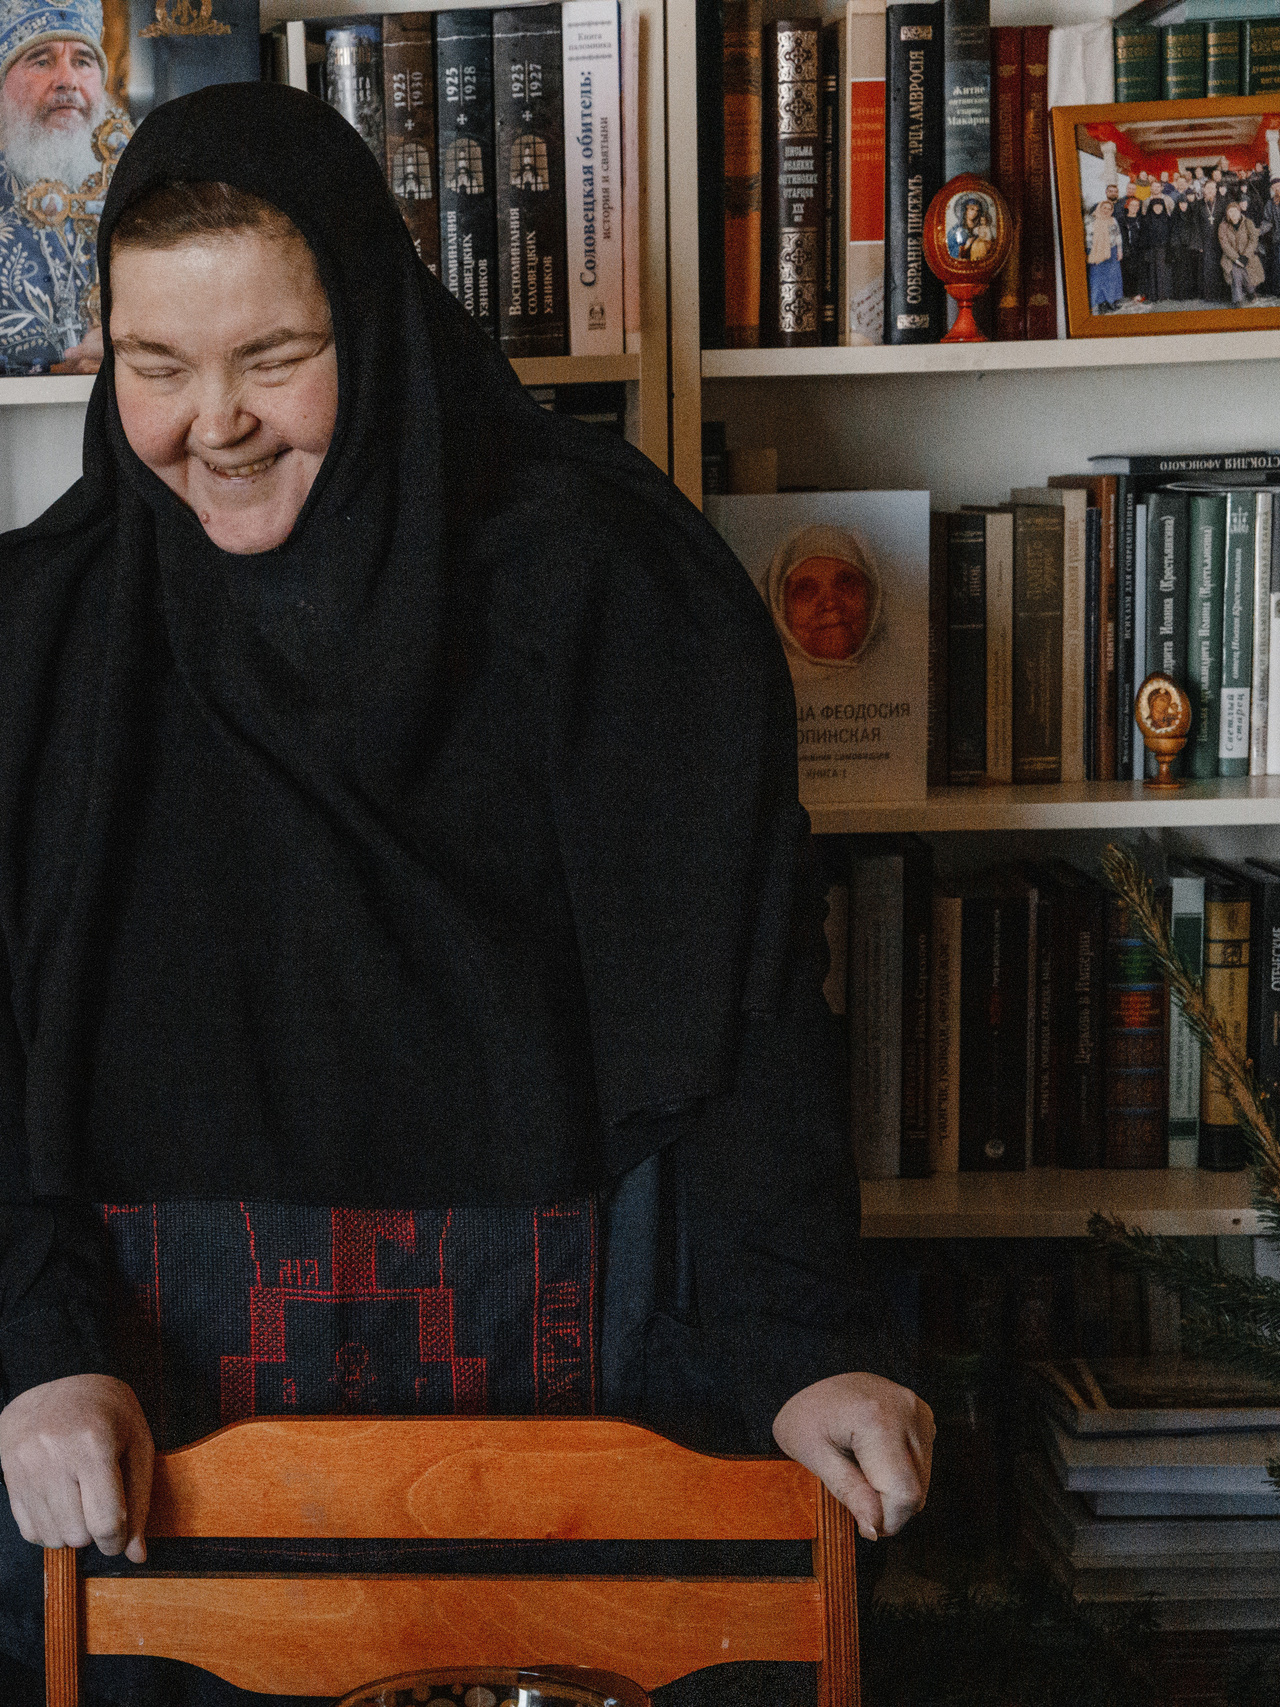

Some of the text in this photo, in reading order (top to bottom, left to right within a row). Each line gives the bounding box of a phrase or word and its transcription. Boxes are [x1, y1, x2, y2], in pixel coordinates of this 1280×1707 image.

[392, 72, 406, 108] 1925
[445, 66, 459, 102] 1925
[463, 65, 477, 102] 1928
[510, 63, 524, 99] 1923
[529, 62, 543, 98] 1927
[908, 49, 925, 122] АМВРОСІЯ
[575, 70, 599, 288] Соловецкая обитель:
[598, 116, 614, 240] история и святыни
[906, 174, 924, 233] ПИСЕМЪ
[447, 210, 460, 299] СПОМИНАНИЯ
[906, 237, 924, 305] СОБРАНІЕ
[1224, 456, 1280, 470] СТОКЛИЯ
[1159, 515, 1176, 592] (Крестьянкина)
[1159, 597, 1174, 635] Иоанна
[798, 727, 881, 744] ОПИНСКАЯ
[821, 702, 911, 721] ФЕОДОСИЯ
[1234, 692, 1247, 742] старец
[1074, 931, 1095, 992] Империи
[1074, 1008, 1094, 1064] Церковь
